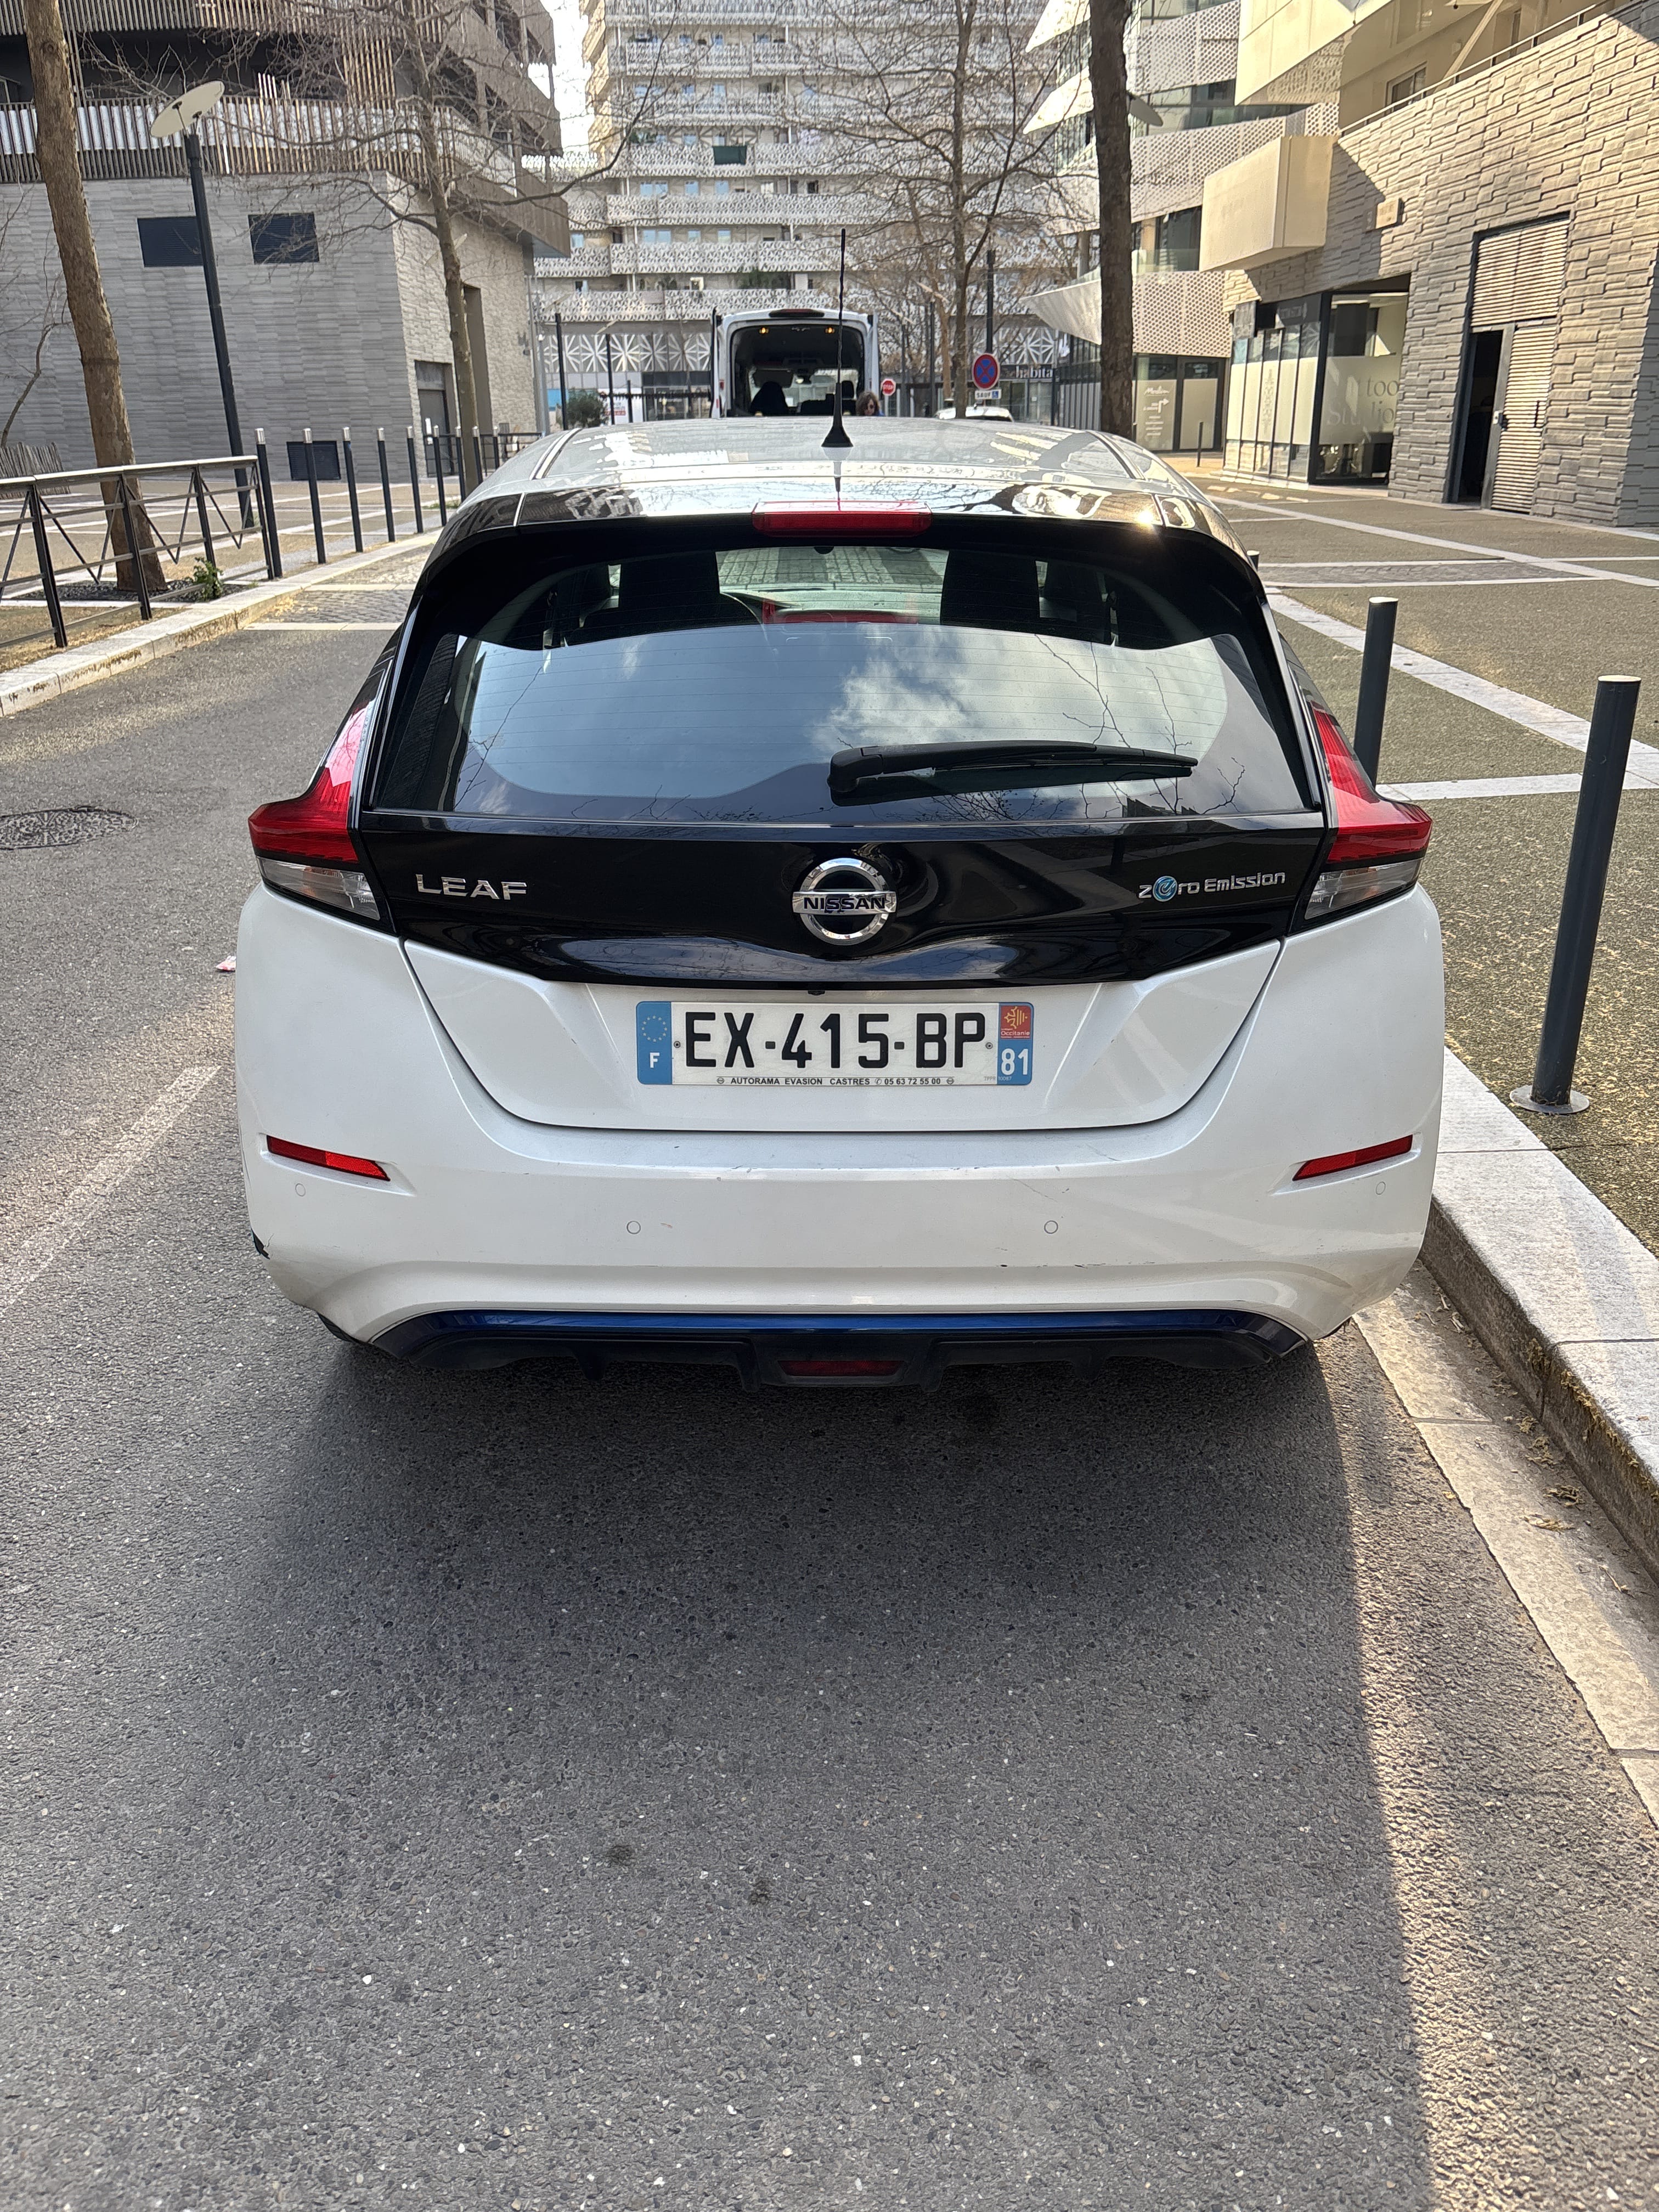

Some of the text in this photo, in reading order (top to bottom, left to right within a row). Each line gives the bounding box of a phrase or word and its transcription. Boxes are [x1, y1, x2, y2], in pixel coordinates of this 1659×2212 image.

[1015, 365, 1053, 379] habita
[415, 874, 527, 900] LEAF
[1204, 872, 1285, 893] Emission
[803, 896, 885, 910] NISSAN
[685, 1012, 985, 1069] EX-415-BP
[650, 1052, 660, 1068] F
[1001, 1048, 1029, 1076] 81
